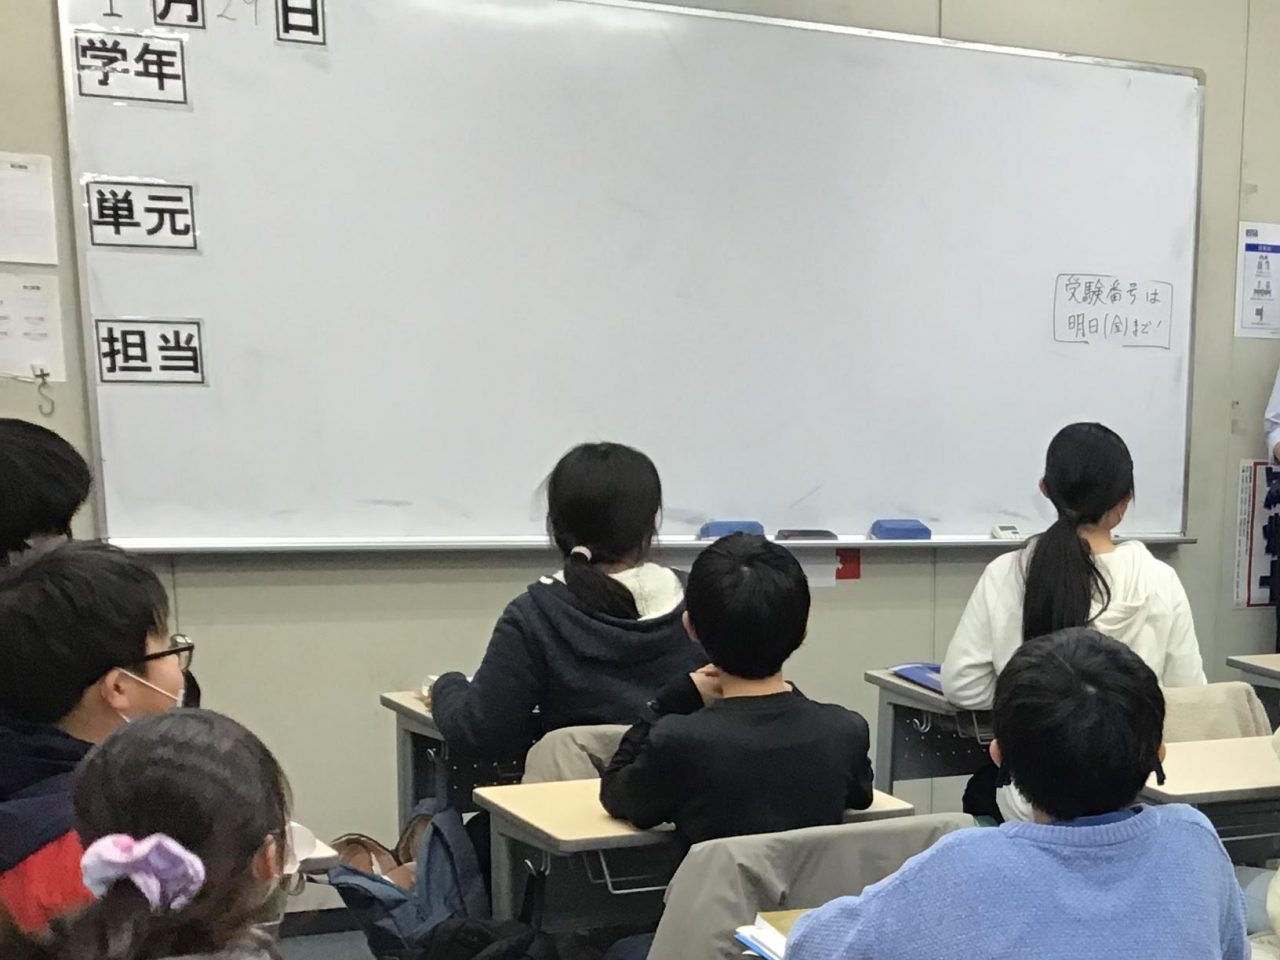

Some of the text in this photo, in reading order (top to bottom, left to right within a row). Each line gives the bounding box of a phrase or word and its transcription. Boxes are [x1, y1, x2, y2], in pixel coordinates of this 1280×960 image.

[79, 38, 182, 91] 学年
[92, 189, 192, 236] 単元
[1065, 275, 1161, 306] 受験番号は
[101, 326, 200, 373] 担当
